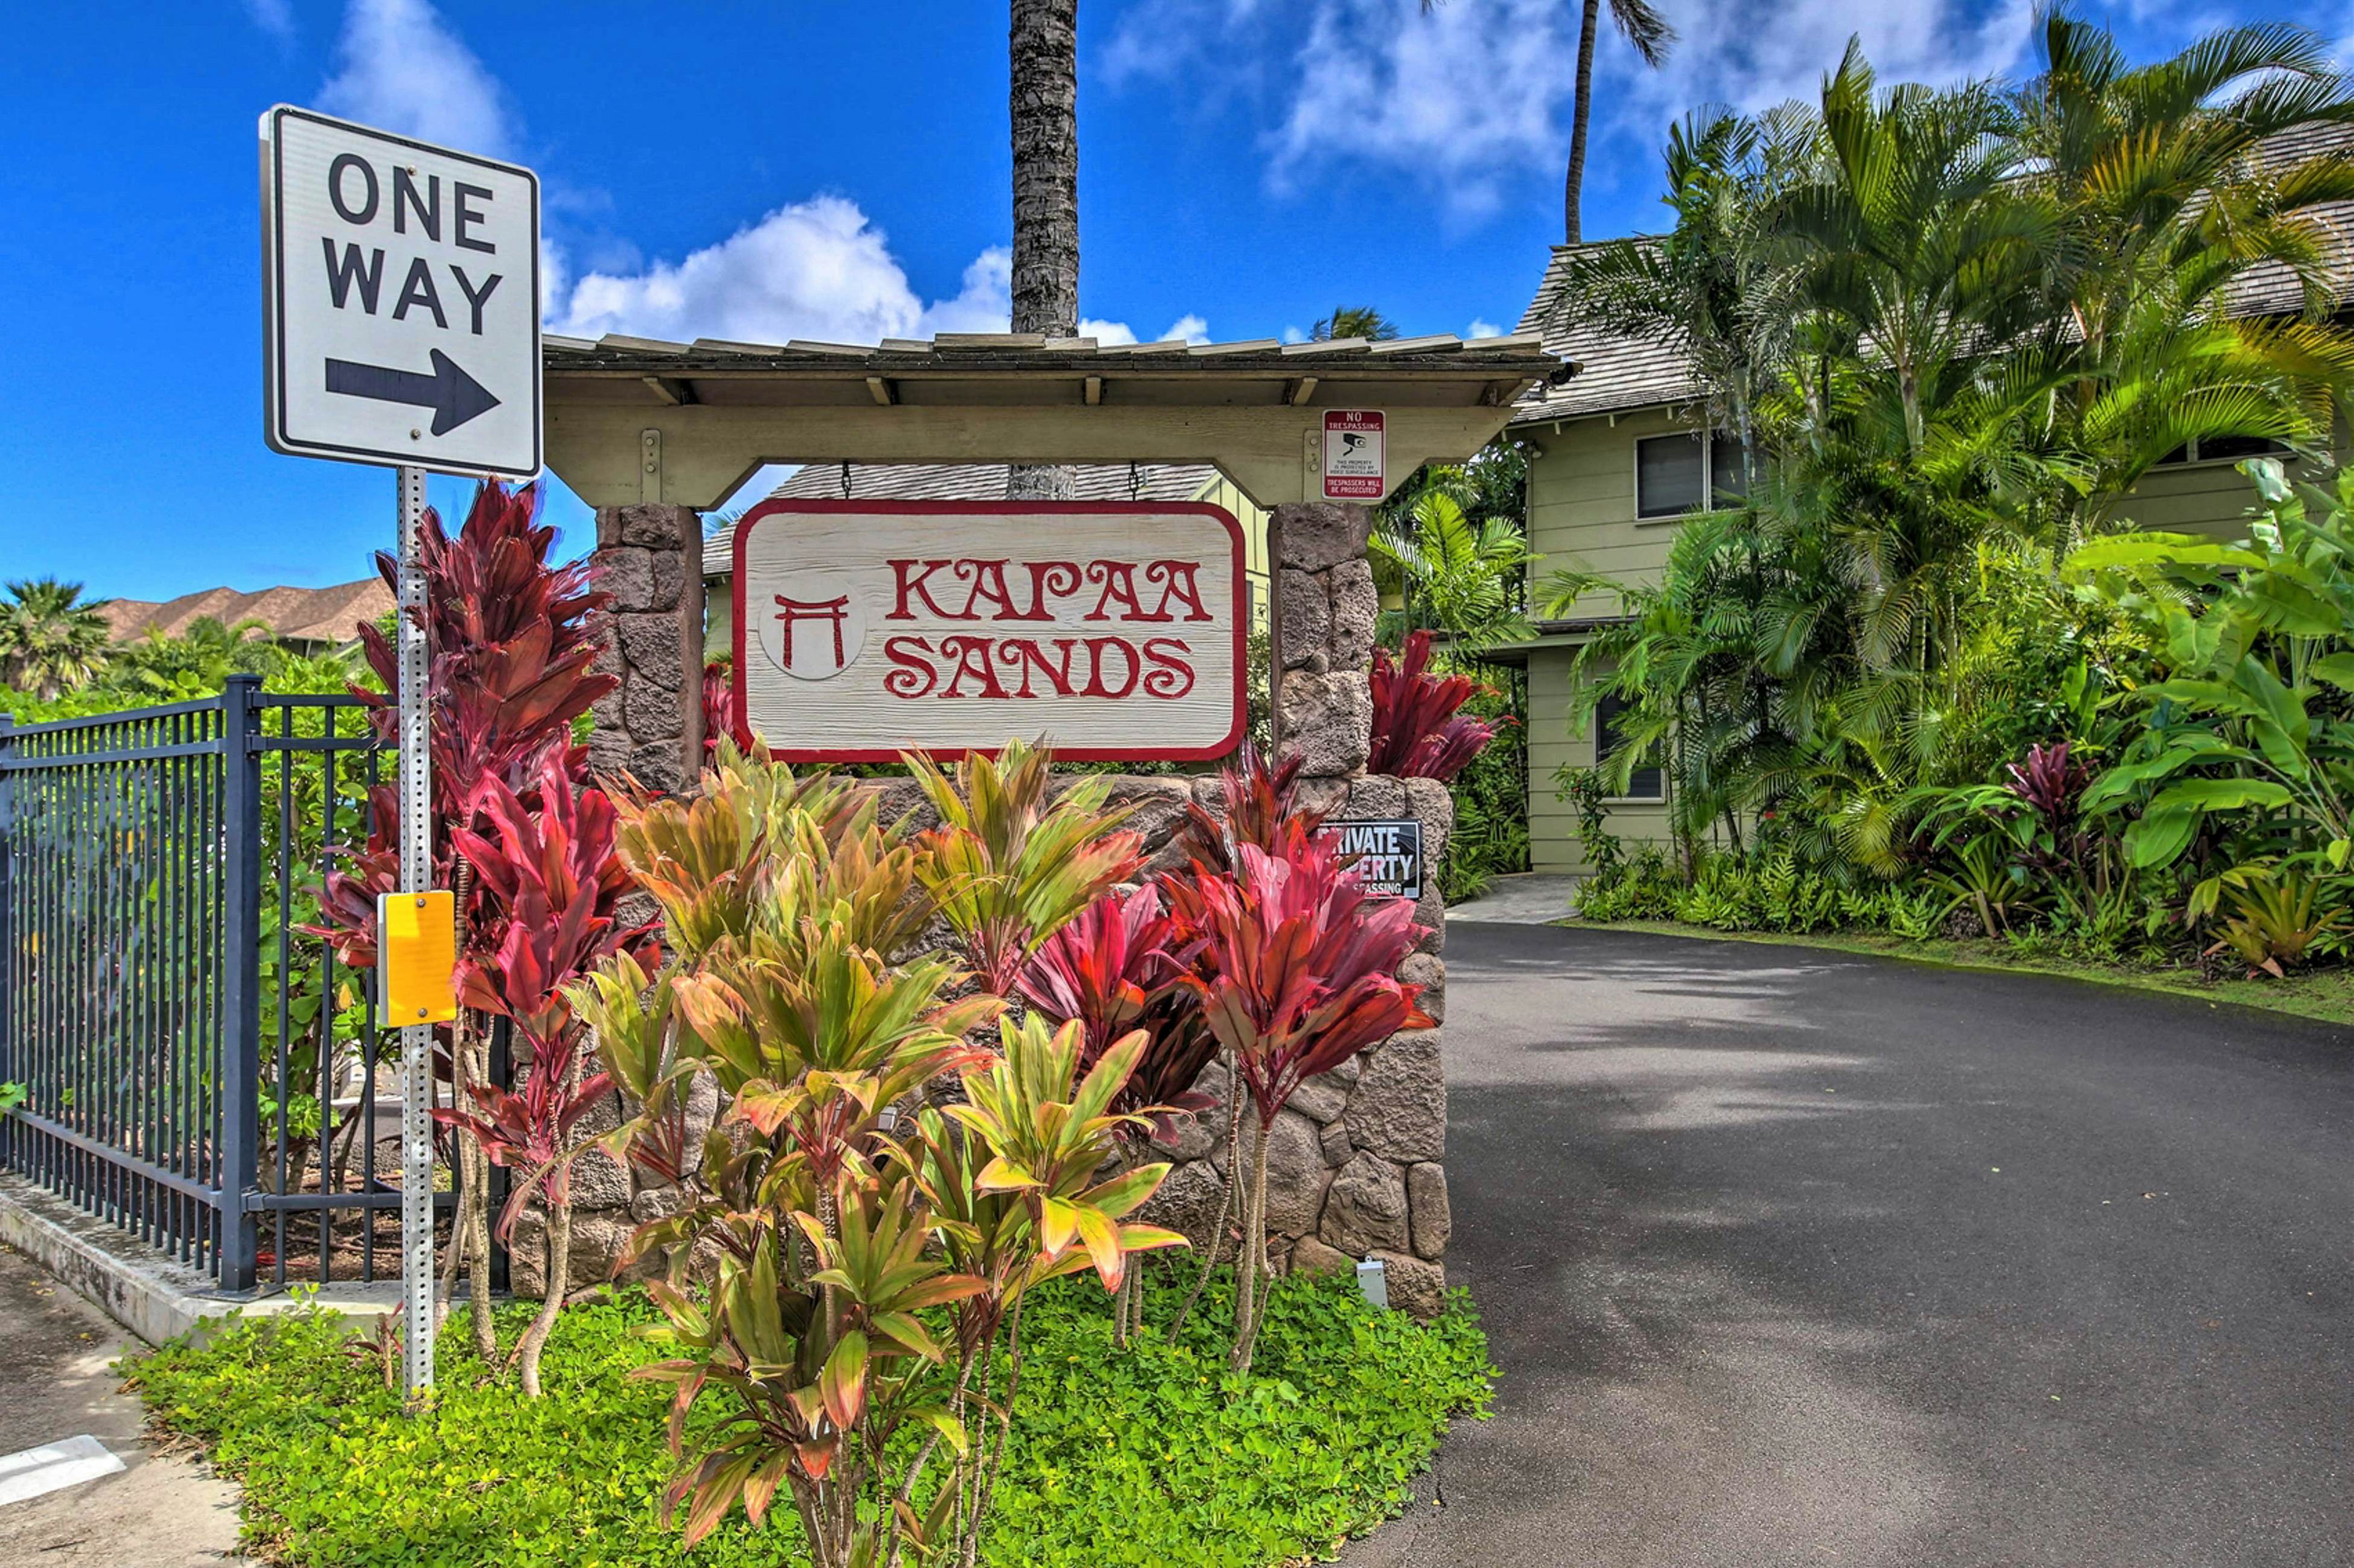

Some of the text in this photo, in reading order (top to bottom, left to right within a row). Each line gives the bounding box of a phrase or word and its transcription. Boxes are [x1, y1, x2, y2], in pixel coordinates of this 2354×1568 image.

[328, 153, 496, 255] ONE
[322, 237, 503, 336] WAY
[1347, 412, 1362, 422] NO
[885, 558, 1214, 622] KAPAA
[883, 636, 1197, 700] SANDS
[1325, 855, 1414, 881] ERTY
